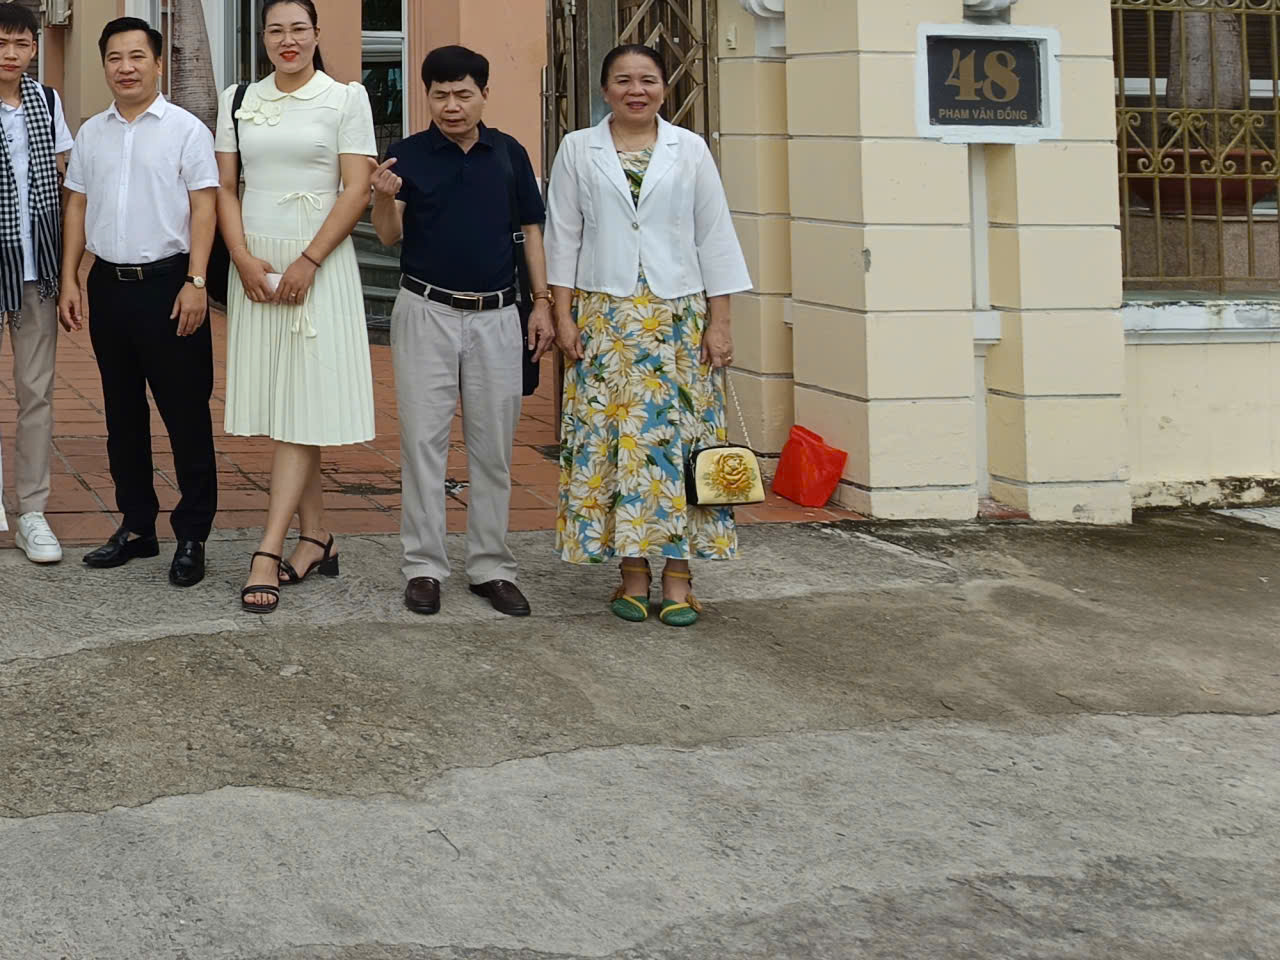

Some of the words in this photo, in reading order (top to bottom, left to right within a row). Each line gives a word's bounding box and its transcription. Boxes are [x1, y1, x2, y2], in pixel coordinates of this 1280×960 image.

[944, 48, 1020, 102] 48
[938, 108, 970, 120] PHẠM
[972, 106, 994, 120] VĂN
